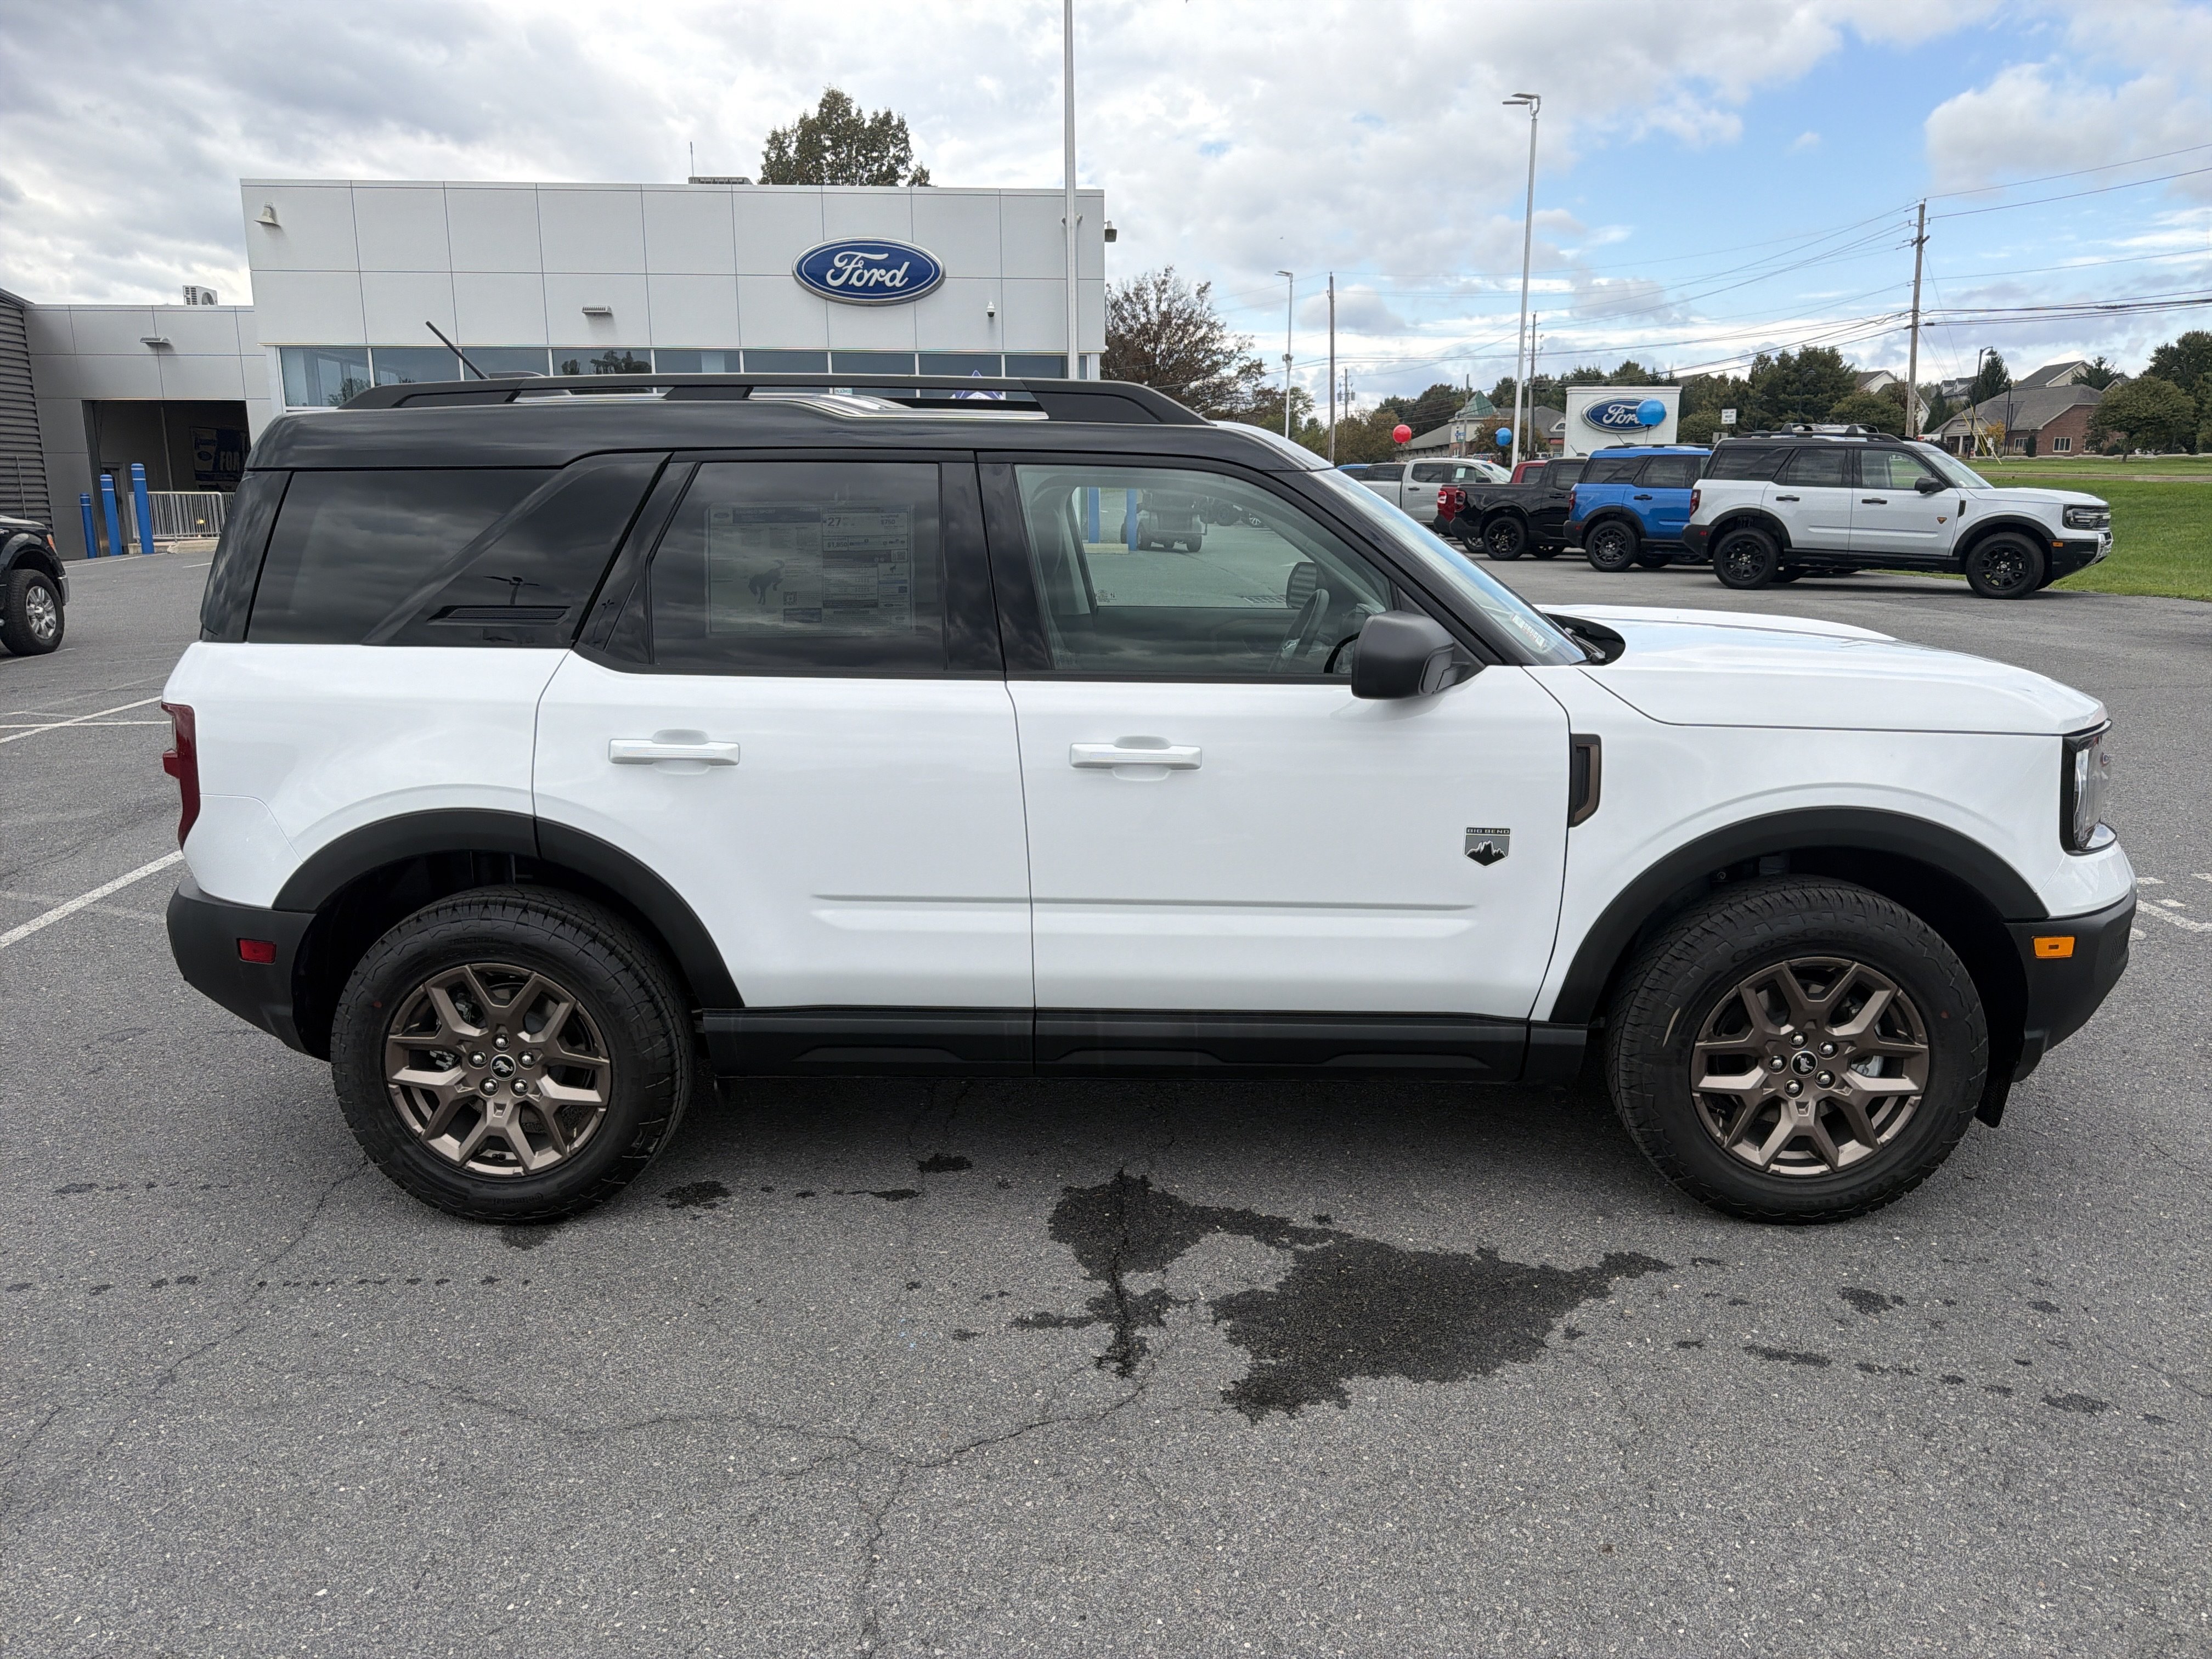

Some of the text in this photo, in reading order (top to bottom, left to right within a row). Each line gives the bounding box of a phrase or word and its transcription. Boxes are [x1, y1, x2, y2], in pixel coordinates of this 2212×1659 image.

[826, 251, 910, 287] Ford
[1602, 404, 1640, 424] For
[827, 517, 841, 527] 27
